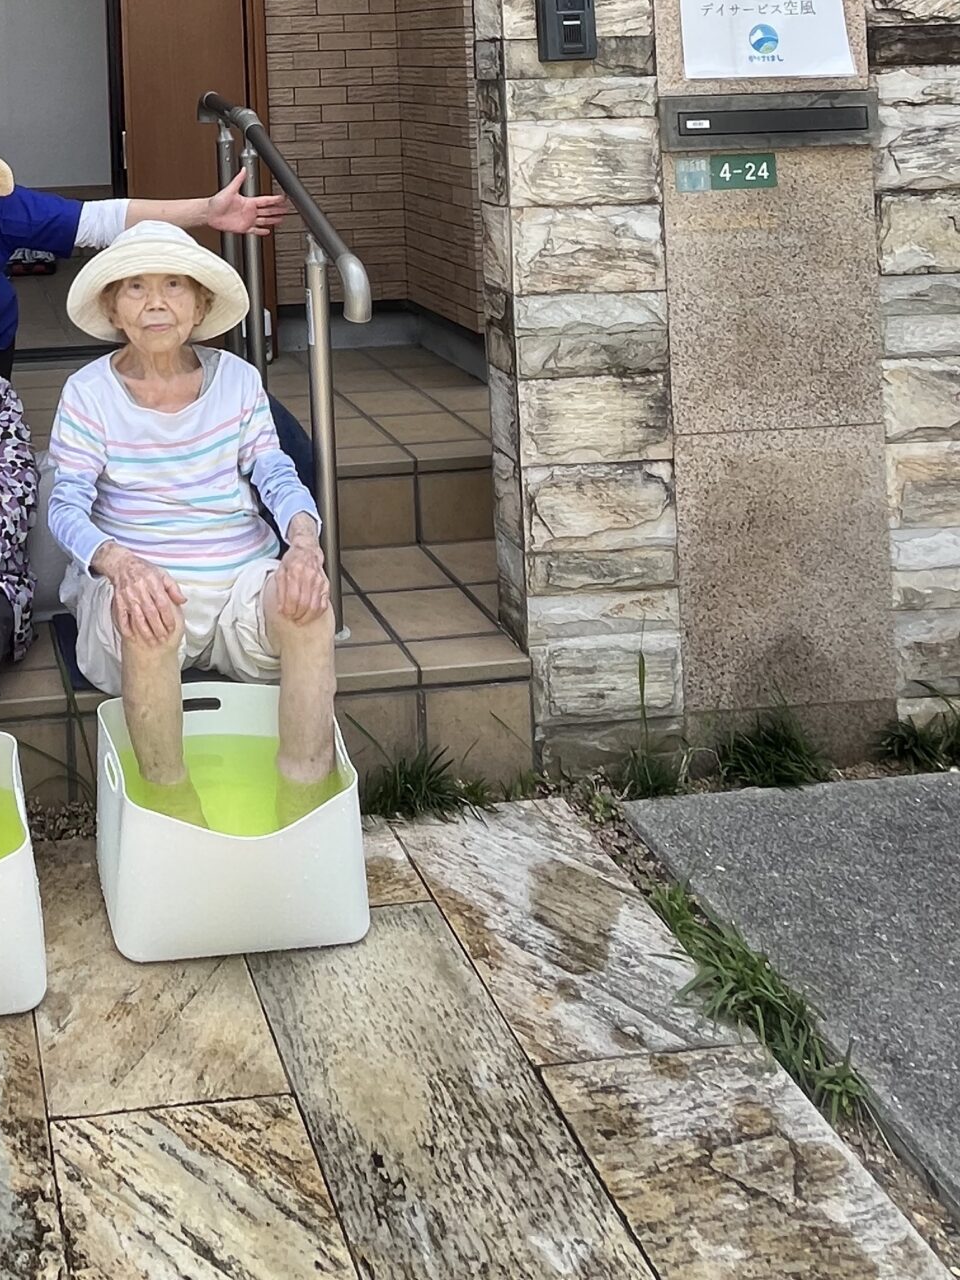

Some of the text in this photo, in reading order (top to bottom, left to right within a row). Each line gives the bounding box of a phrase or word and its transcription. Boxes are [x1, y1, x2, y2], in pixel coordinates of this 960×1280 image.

[700, 0, 816, 16] デイサービス空風
[719, 162, 770, 181] 4-24
